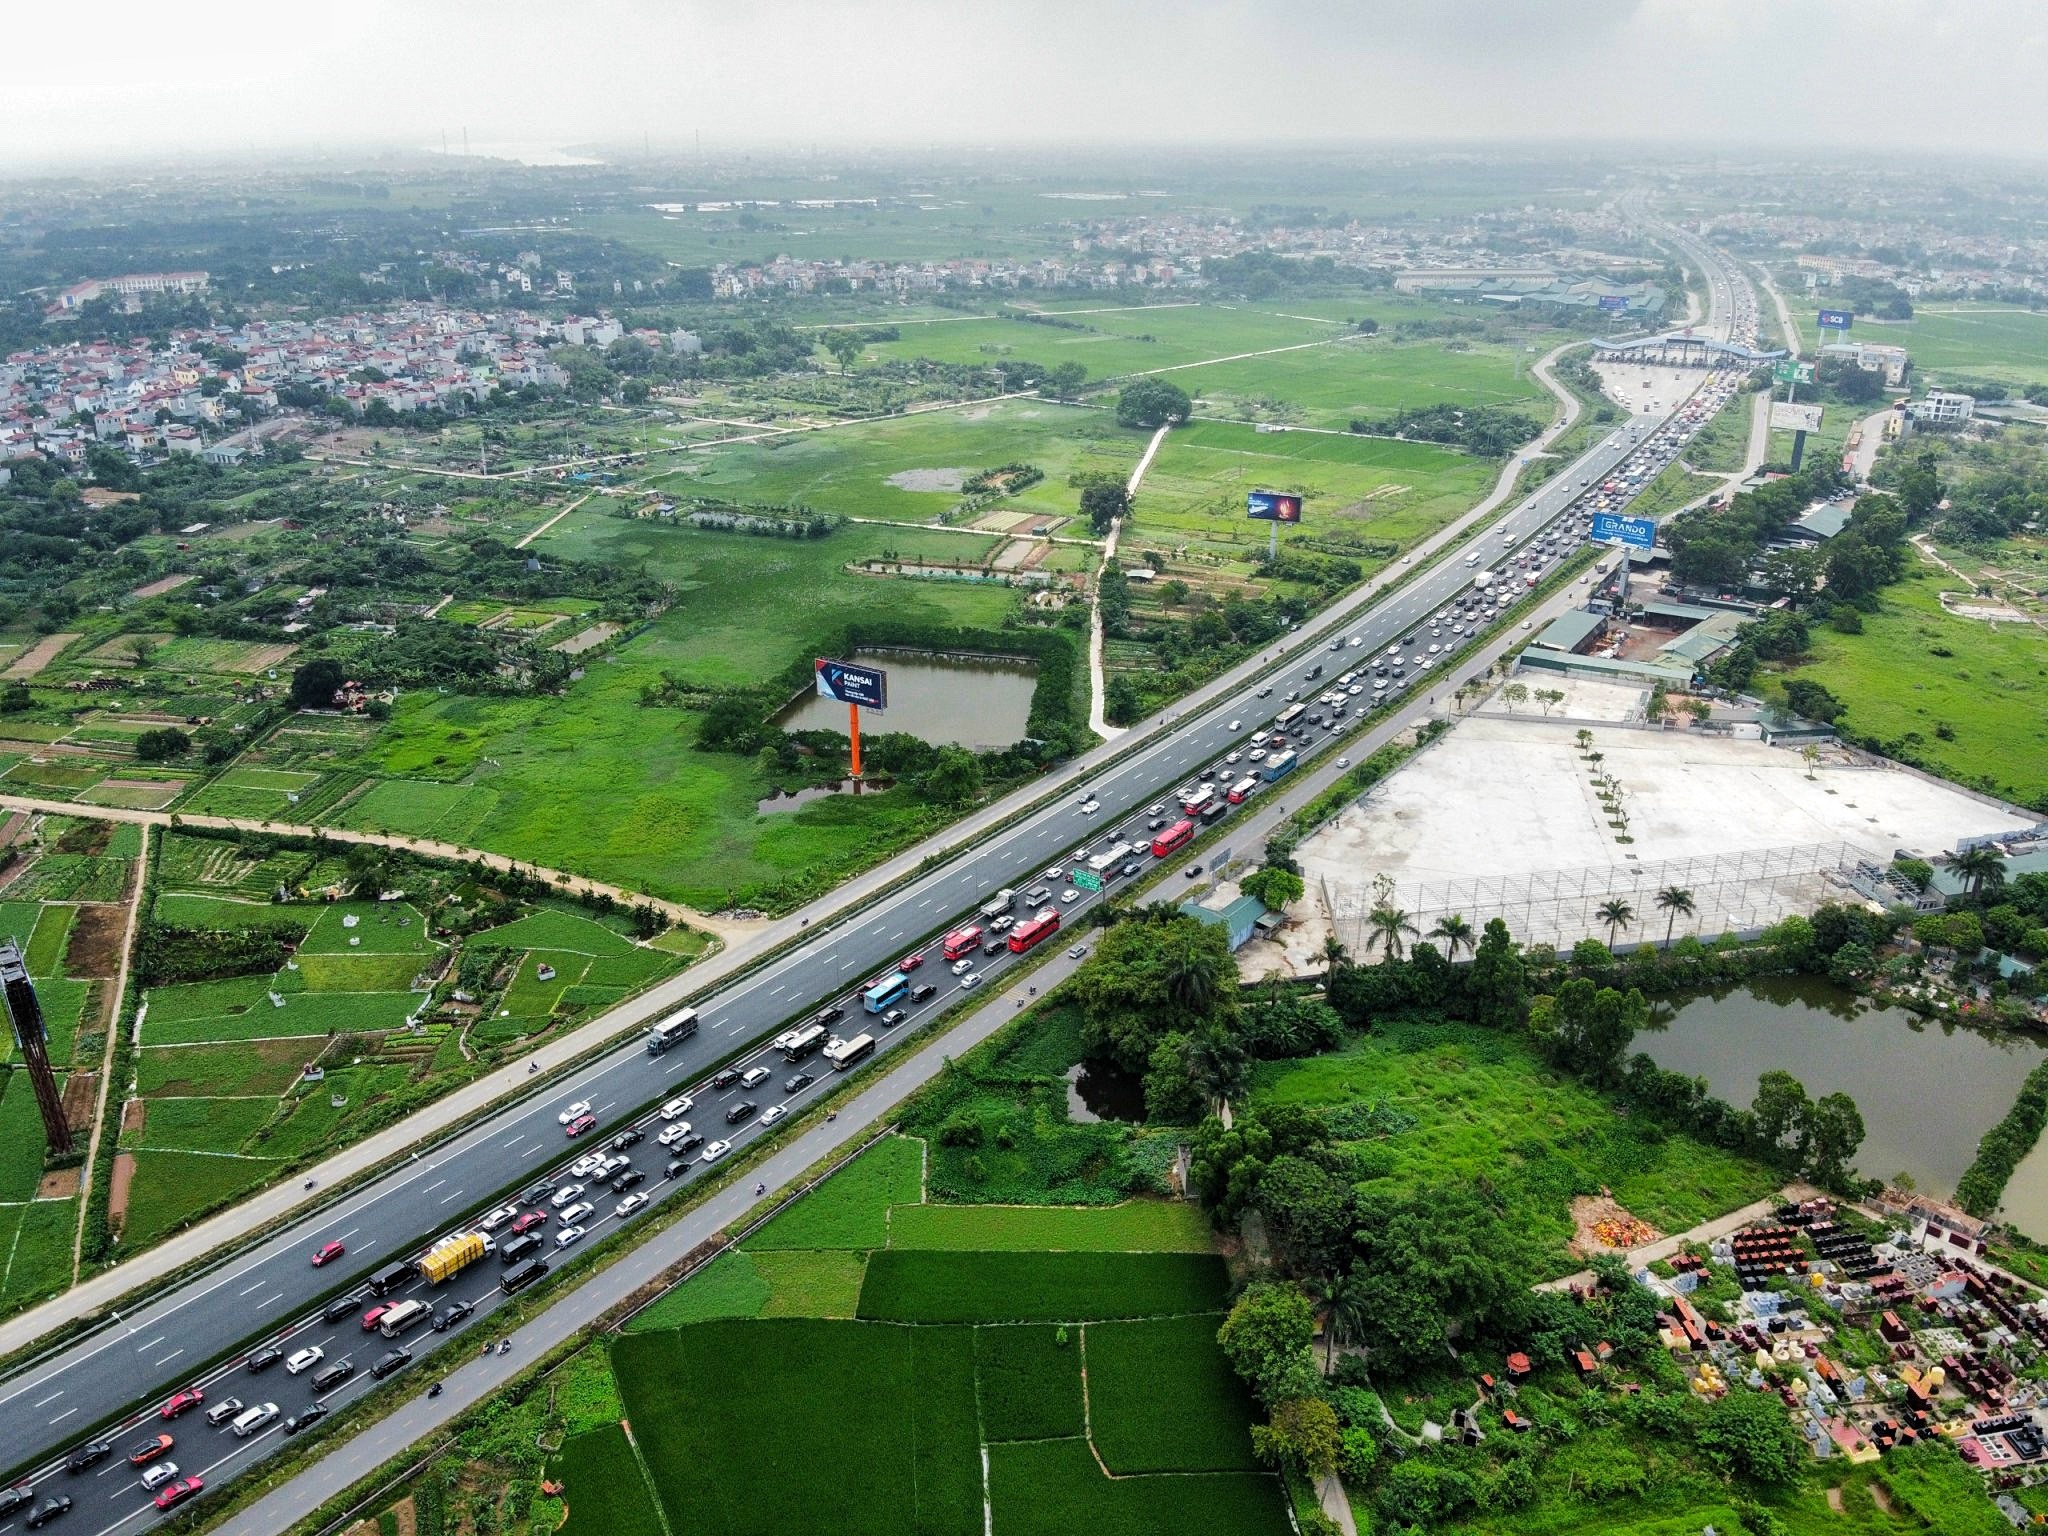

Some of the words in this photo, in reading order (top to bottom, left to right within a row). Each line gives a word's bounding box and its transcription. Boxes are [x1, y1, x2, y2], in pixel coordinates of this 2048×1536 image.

[1830, 315, 1844, 324] SCB
[1605, 521, 1646, 535] GRANDO
[843, 672, 872, 686] KANSAI
